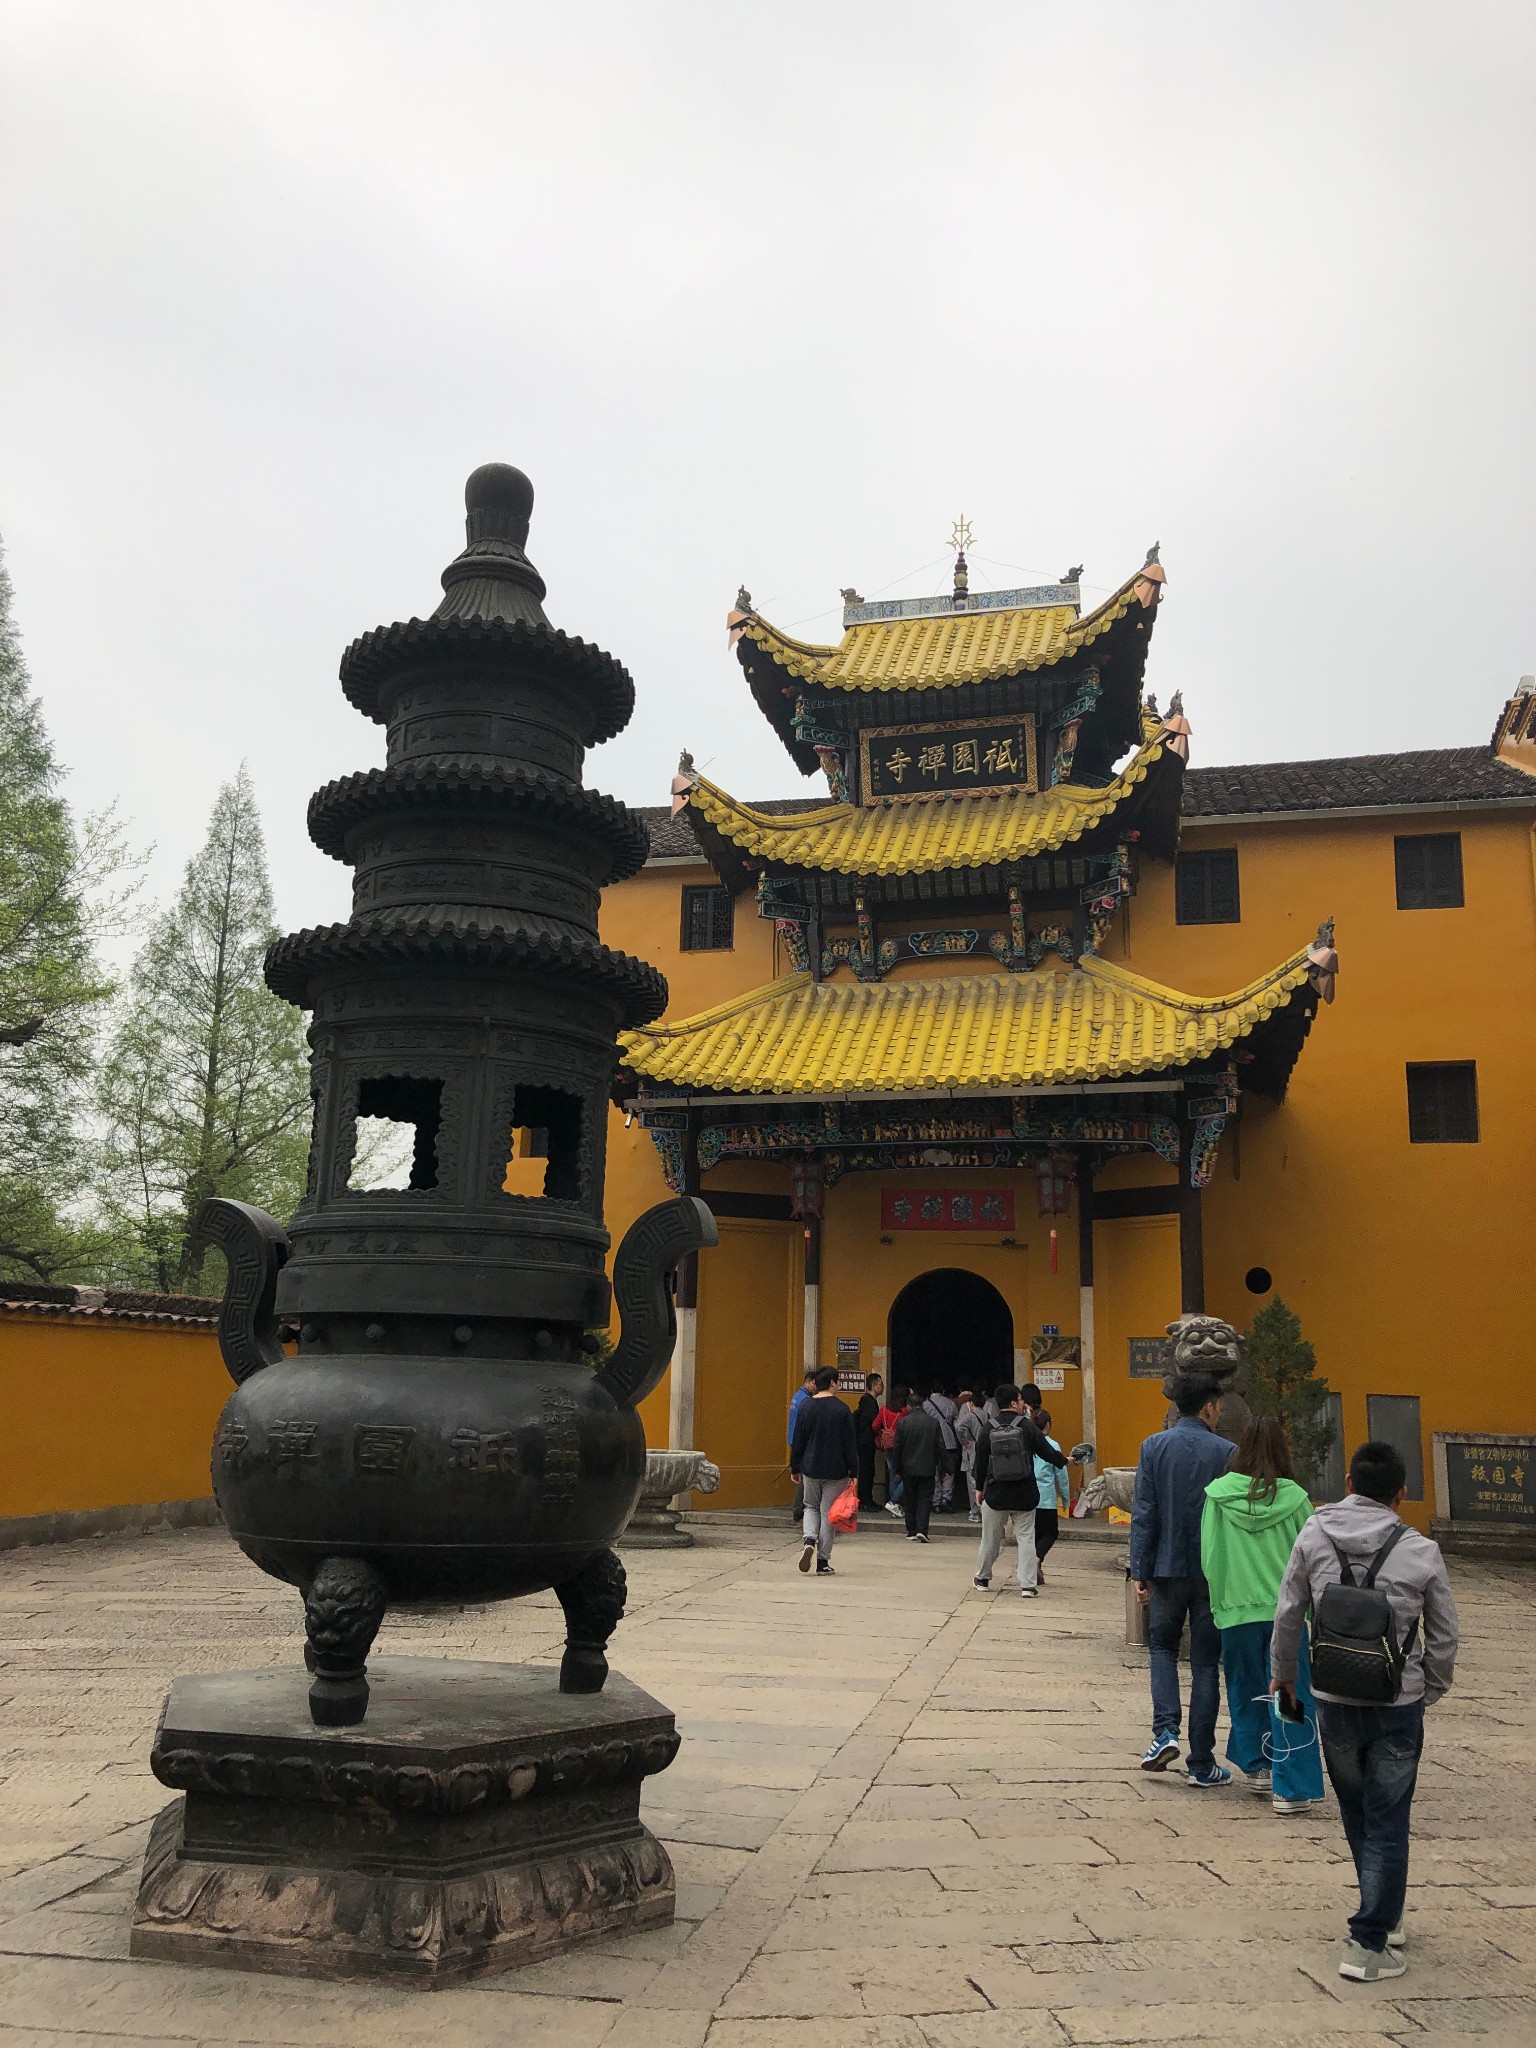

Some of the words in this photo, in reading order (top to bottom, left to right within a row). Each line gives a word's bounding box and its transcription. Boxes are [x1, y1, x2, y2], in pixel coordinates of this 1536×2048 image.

[842, 1381, 865, 1390] 请勿吸烟
[1463, 1446, 1530, 1462] 安徽省文物保护单位
[1477, 1490, 1524, 1503] 安徽省人民政府
